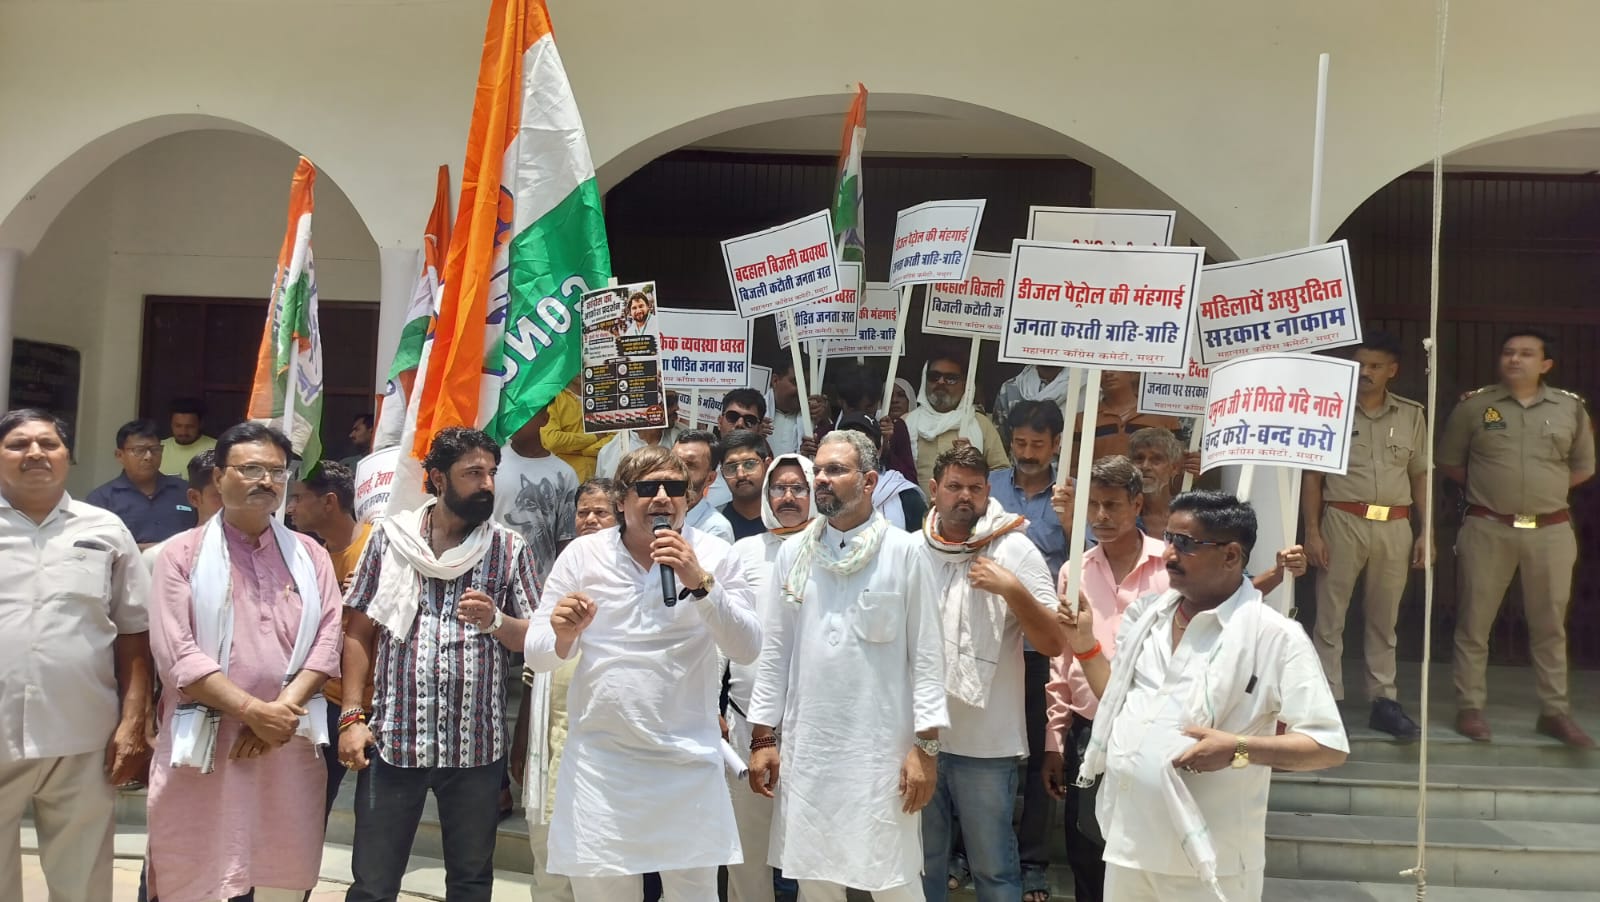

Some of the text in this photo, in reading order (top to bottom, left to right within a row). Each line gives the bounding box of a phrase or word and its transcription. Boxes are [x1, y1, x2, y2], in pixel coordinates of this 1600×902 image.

[926, 228, 937, 242] की
[939, 226, 970, 243] मंहगाई
[734, 242, 829, 282] बदहाल बिजली व्यवस्था
[904, 251, 920, 268] करती
[921, 250, 963, 265] त्राहि-त्राहि
[738, 265, 831, 302] बिजली कटौती जनता त्रस्त
[935, 276, 1005, 298] बदहाल बिजली
[1018, 277, 1186, 309] डीजल पैट्रोल की मंहगाई
[931, 297, 963, 314] बिजली
[964, 301, 991, 317] कटौती
[1200, 278, 1343, 320] महिलायें असुरक्षित
[816, 311, 840, 323] जनता
[841, 311, 855, 323] त्रस्त
[859, 307, 897, 321] की मंहगाई
[1013, 317, 1180, 343] जनता करती त्राहि-त्राहि
[1204, 308, 1346, 348] सरकार नाकाम
[681, 337, 718, 353] व्यवस्था
[720, 339, 746, 353] ध्वस्त
[1023, 347, 1059, 355] महानगर
[1136, 353, 1165, 363] मथुरा
[671, 356, 697, 376] पीड़ित
[699, 360, 725, 373] जनता
[727, 361, 744, 373] त्रस्त
[1147, 382, 1171, 396] जनता
[1173, 384, 1184, 397] पर
[1227, 389, 1241, 415] जी
[1242, 387, 1254, 412] में
[1254, 385, 1286, 413] गिरते
[1313, 391, 1344, 419] नाले
[1205, 429, 1222, 451] बन्द
[1298, 424, 1336, 452] करो
